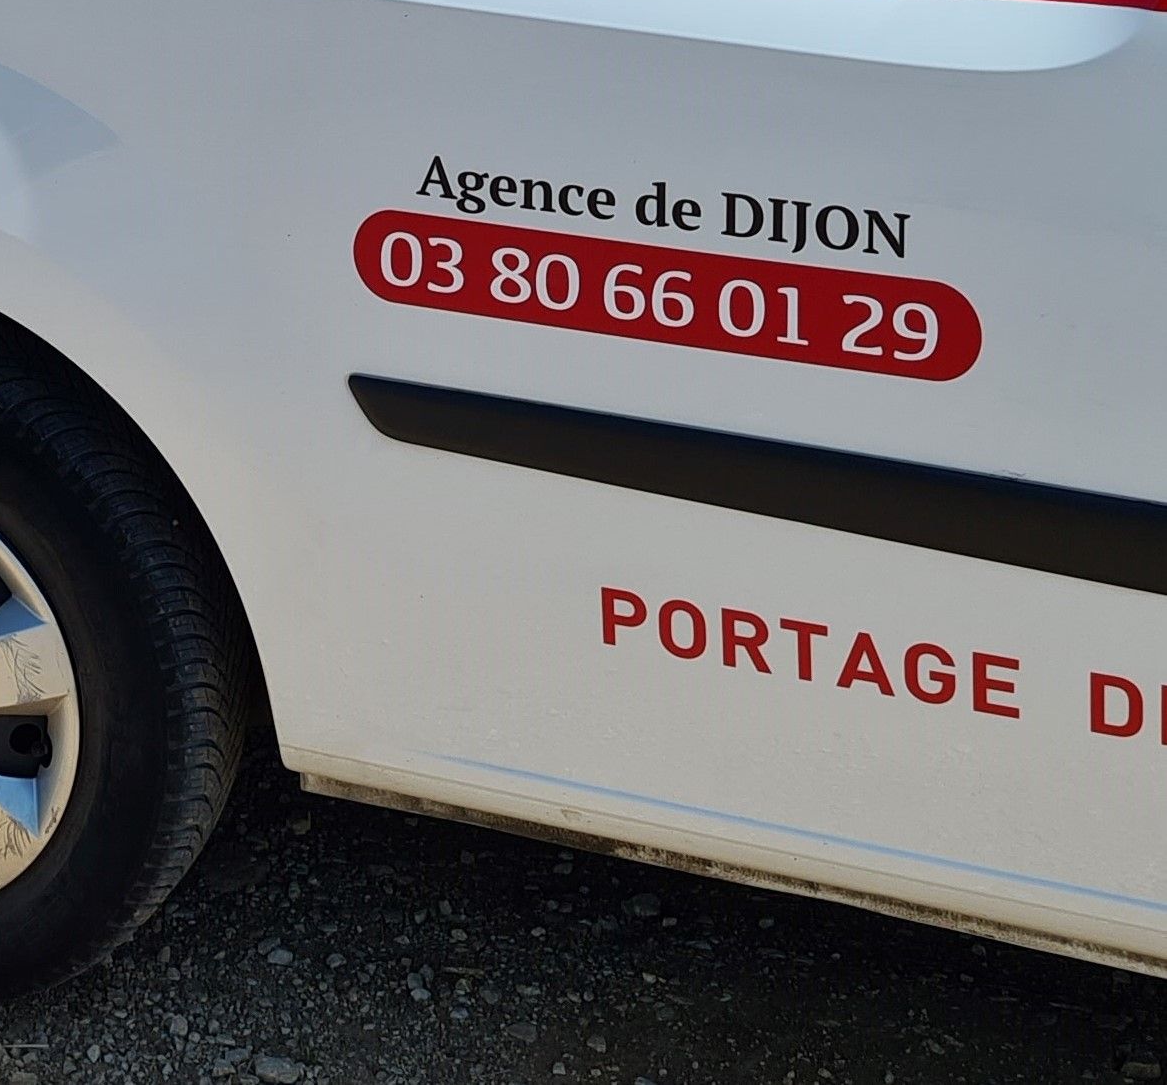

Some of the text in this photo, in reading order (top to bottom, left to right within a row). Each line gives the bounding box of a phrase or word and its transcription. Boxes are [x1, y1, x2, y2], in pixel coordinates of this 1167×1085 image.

[416, 156, 911, 258] Agence de DIJON
[380, 232, 940, 361] 03 80 66 01 29
[600, 587, 1167, 746] PORTAGE D
